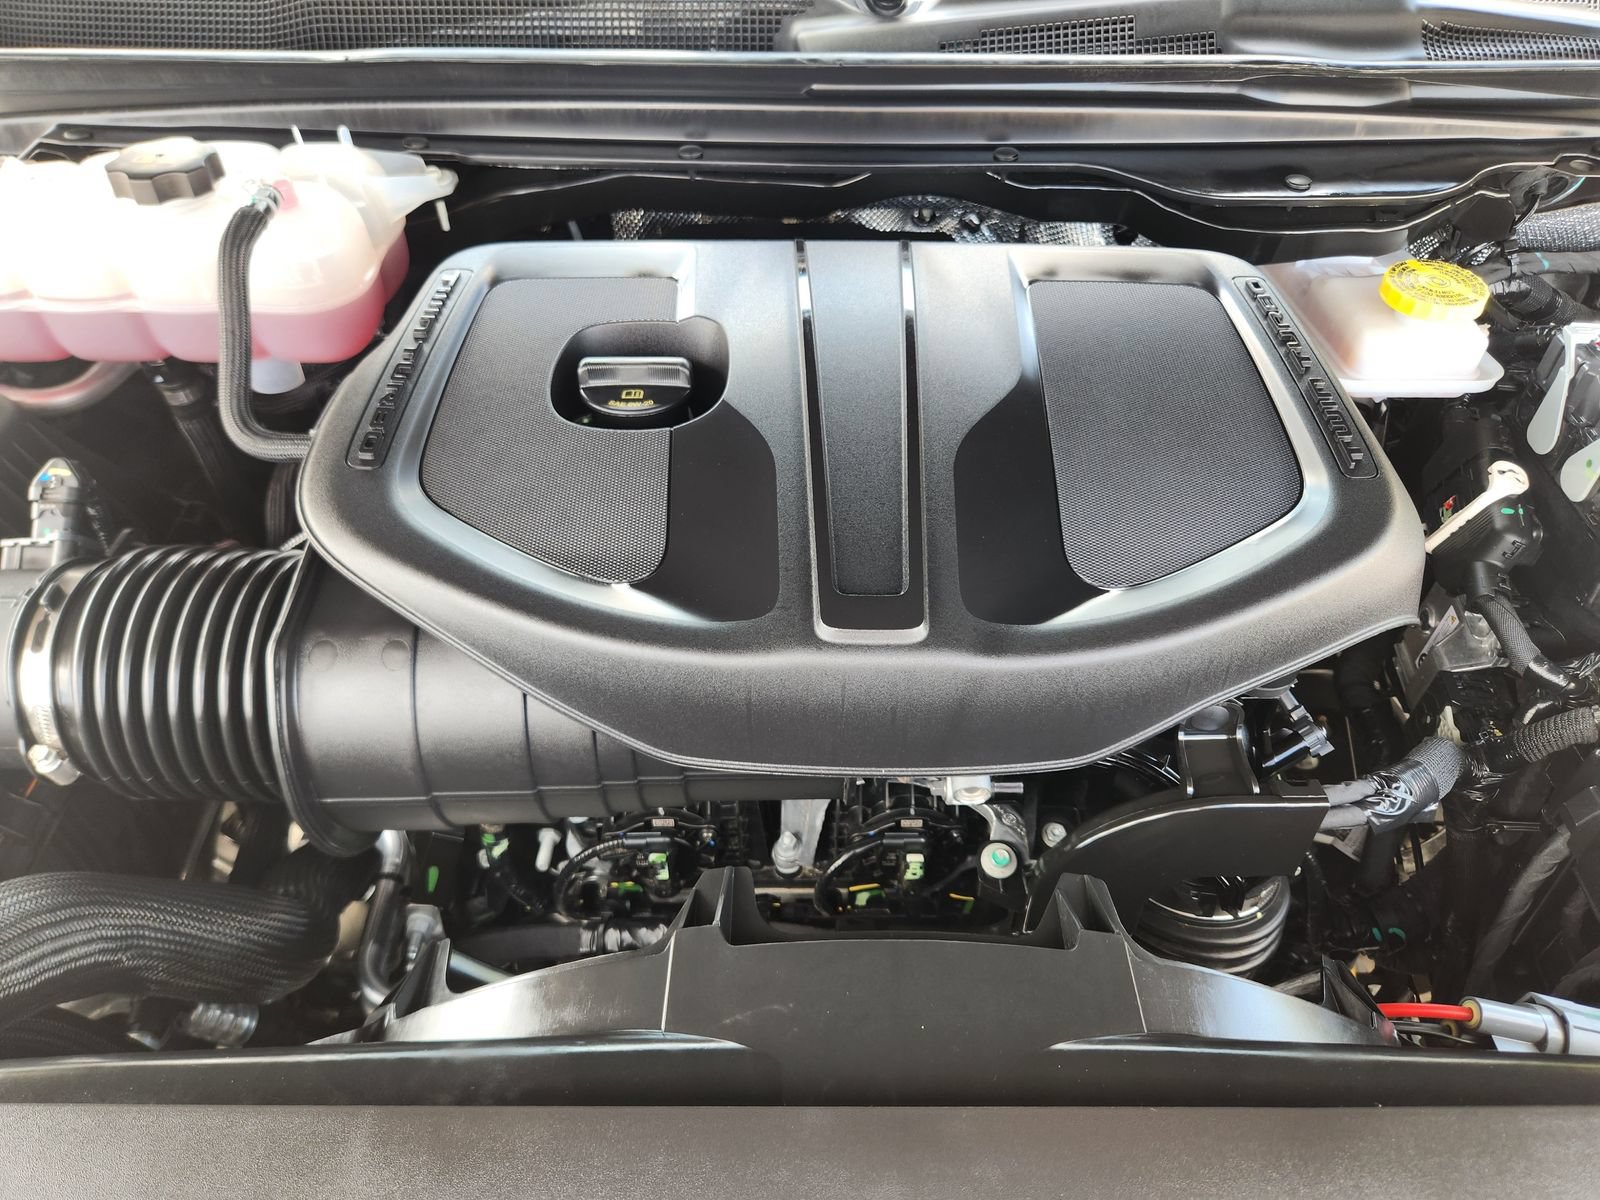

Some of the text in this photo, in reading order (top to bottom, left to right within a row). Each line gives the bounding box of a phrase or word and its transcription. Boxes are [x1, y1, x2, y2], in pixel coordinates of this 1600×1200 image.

[358, 271, 461, 460] TWIN TURBO
[1244, 279, 1364, 469] TWIN TURBO
